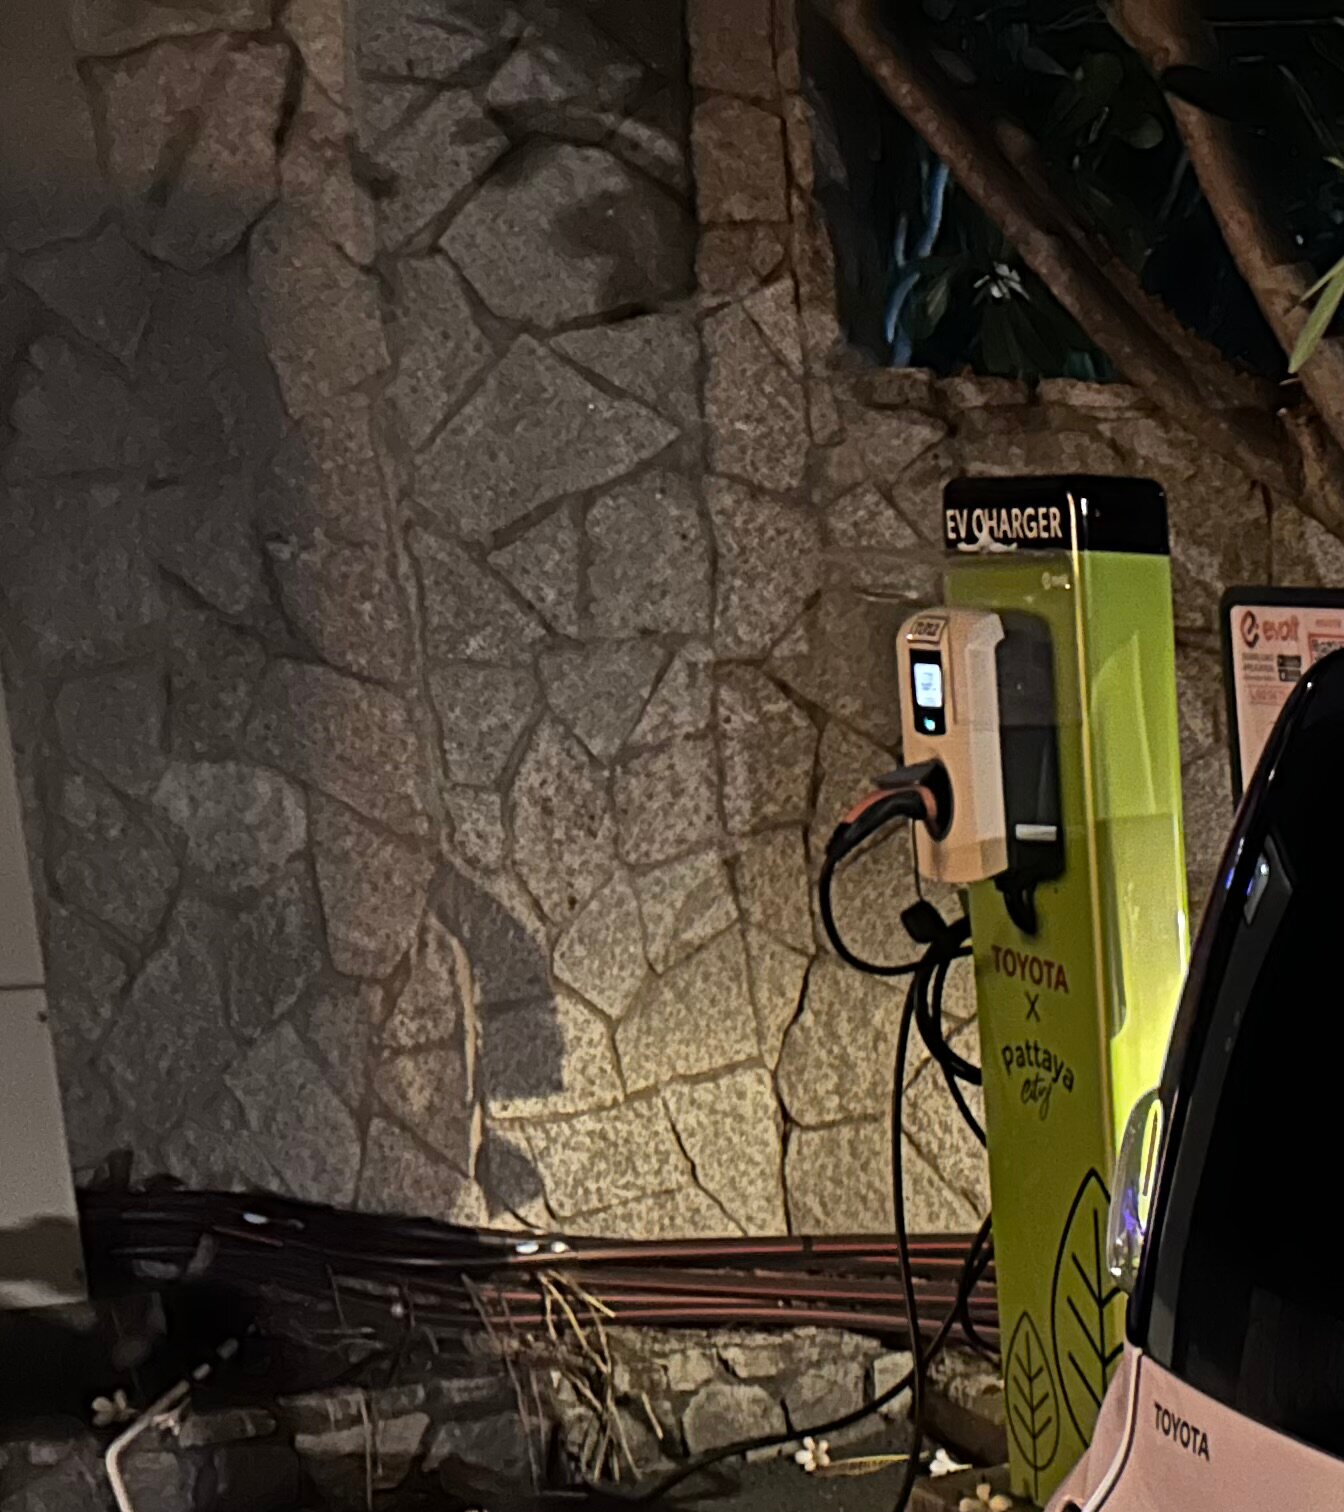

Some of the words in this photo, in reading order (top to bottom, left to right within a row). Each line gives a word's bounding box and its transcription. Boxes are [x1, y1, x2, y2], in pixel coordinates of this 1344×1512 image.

[946, 508, 968, 539] EV
[971, 507, 1063, 539] CHARGER
[991, 945, 1069, 993] TOYOTA
[1025, 992, 1040, 1022] X
[1001, 1040, 1075, 1093] pattaya
[1152, 1402, 1211, 1462] TOYOTA
